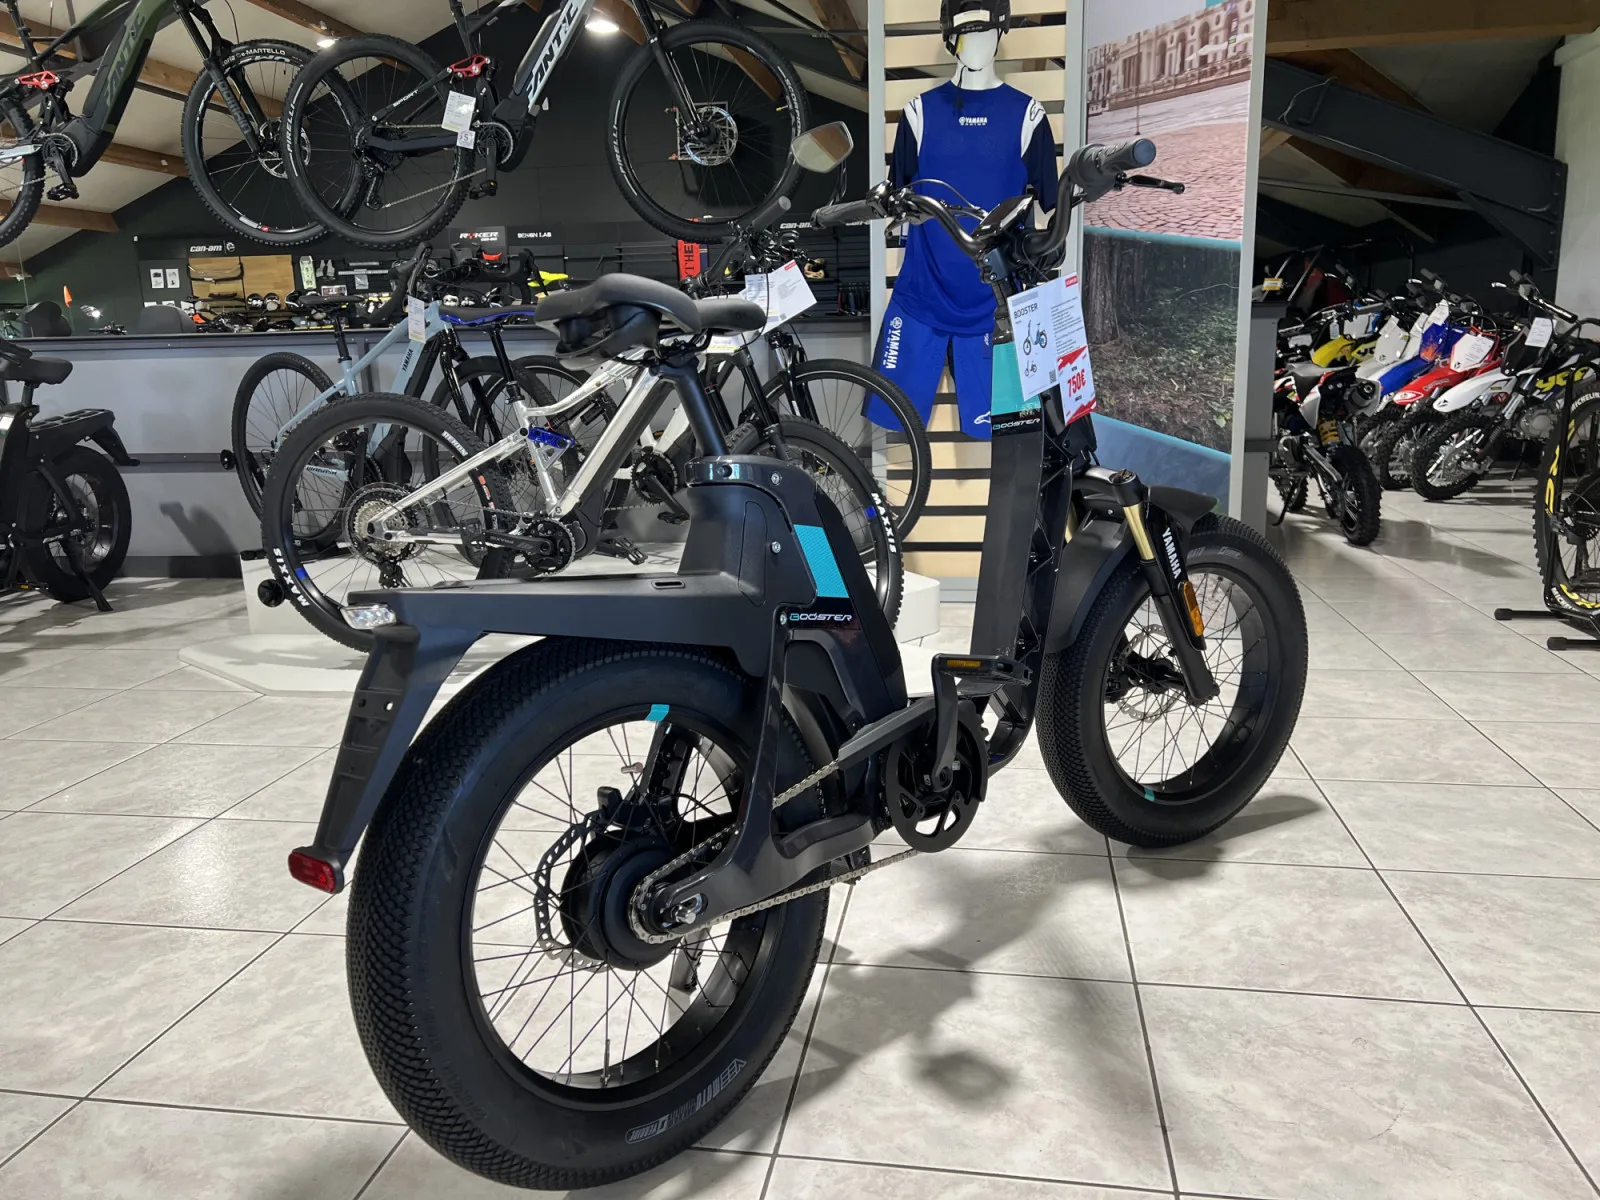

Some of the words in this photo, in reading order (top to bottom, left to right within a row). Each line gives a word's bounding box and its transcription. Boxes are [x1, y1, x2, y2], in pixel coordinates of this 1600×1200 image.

[240, 48, 286, 57] e-MARTELLO
[286, 103, 295, 153] PIRELLI
[613, 124, 626, 174] PIRELLI
[190, 244, 223, 252] can-am
[1014, 302, 1038, 319] BOOSTER
[402, 348, 414, 372] YAMAHA
[886, 329, 901, 369] YAMAHA
[1067, 368, 1086, 398] 750€
[993, 418, 1041, 430] BOOSTER
[871, 492, 897, 553] MAXXIS
[1162, 527, 1182, 579] YAMAHA
[273, 548, 310, 607] MAXXIS
[789, 612, 852, 621] BOOSTER
